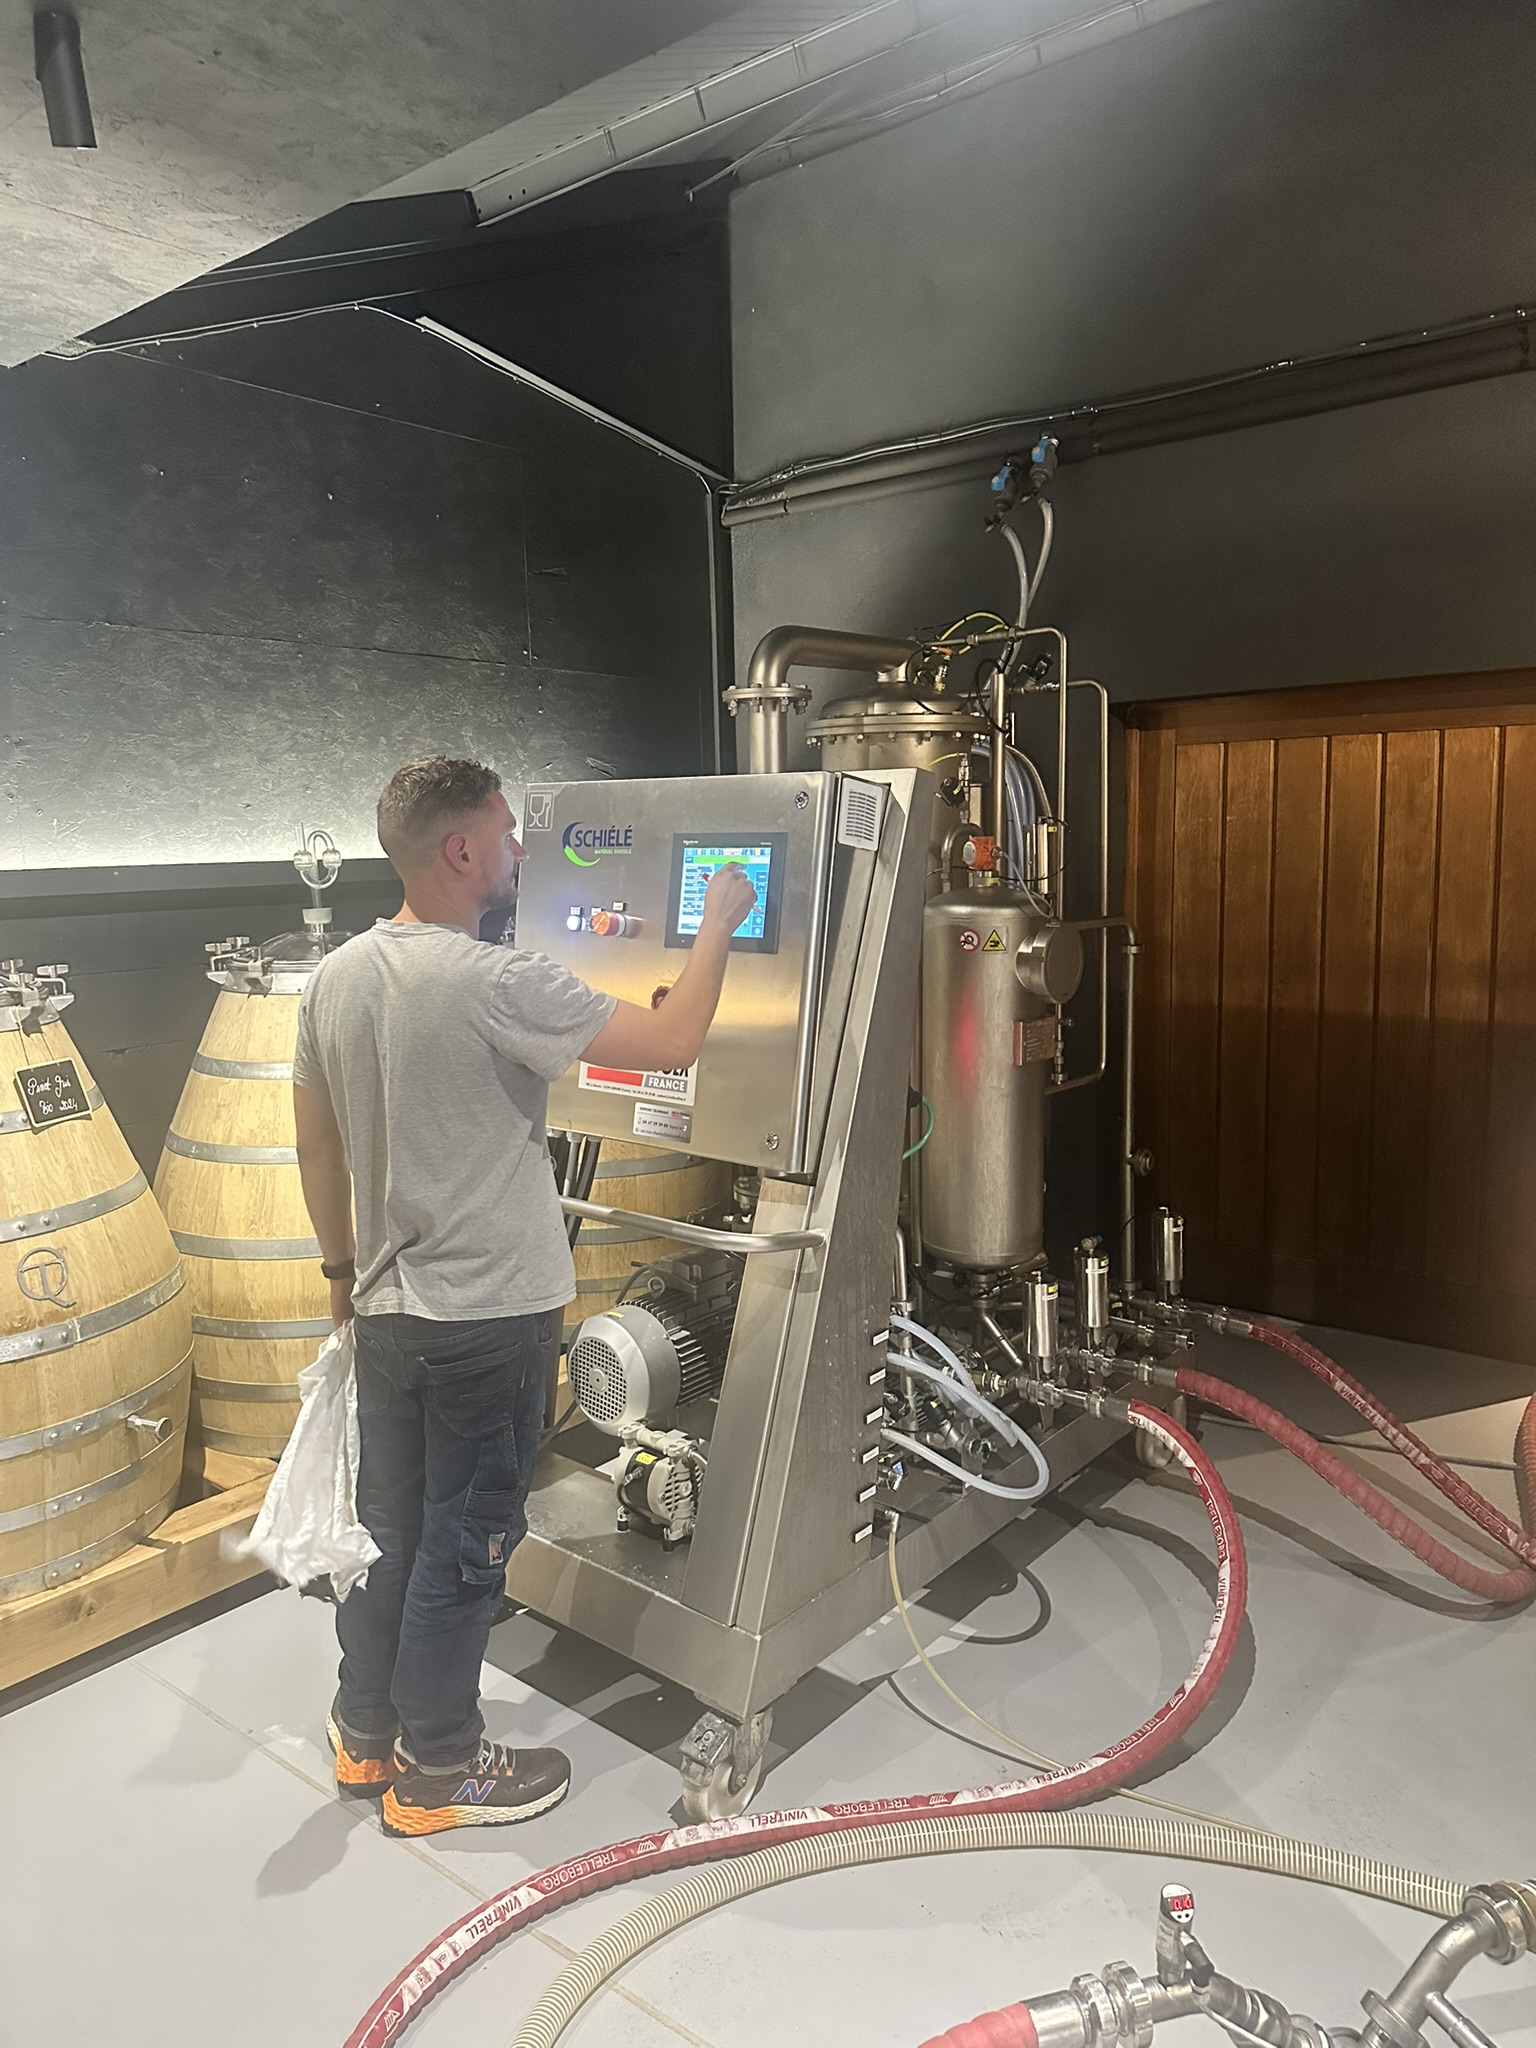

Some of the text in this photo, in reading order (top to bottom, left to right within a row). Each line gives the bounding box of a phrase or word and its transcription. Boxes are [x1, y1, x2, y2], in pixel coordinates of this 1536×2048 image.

[574, 824, 633, 848] SCHIÉLÉ
[648, 1076, 686, 1092] FRANCE
[749, 1811, 808, 1828] VINITRELL
[542, 1850, 619, 1891] TRELLEBORG
